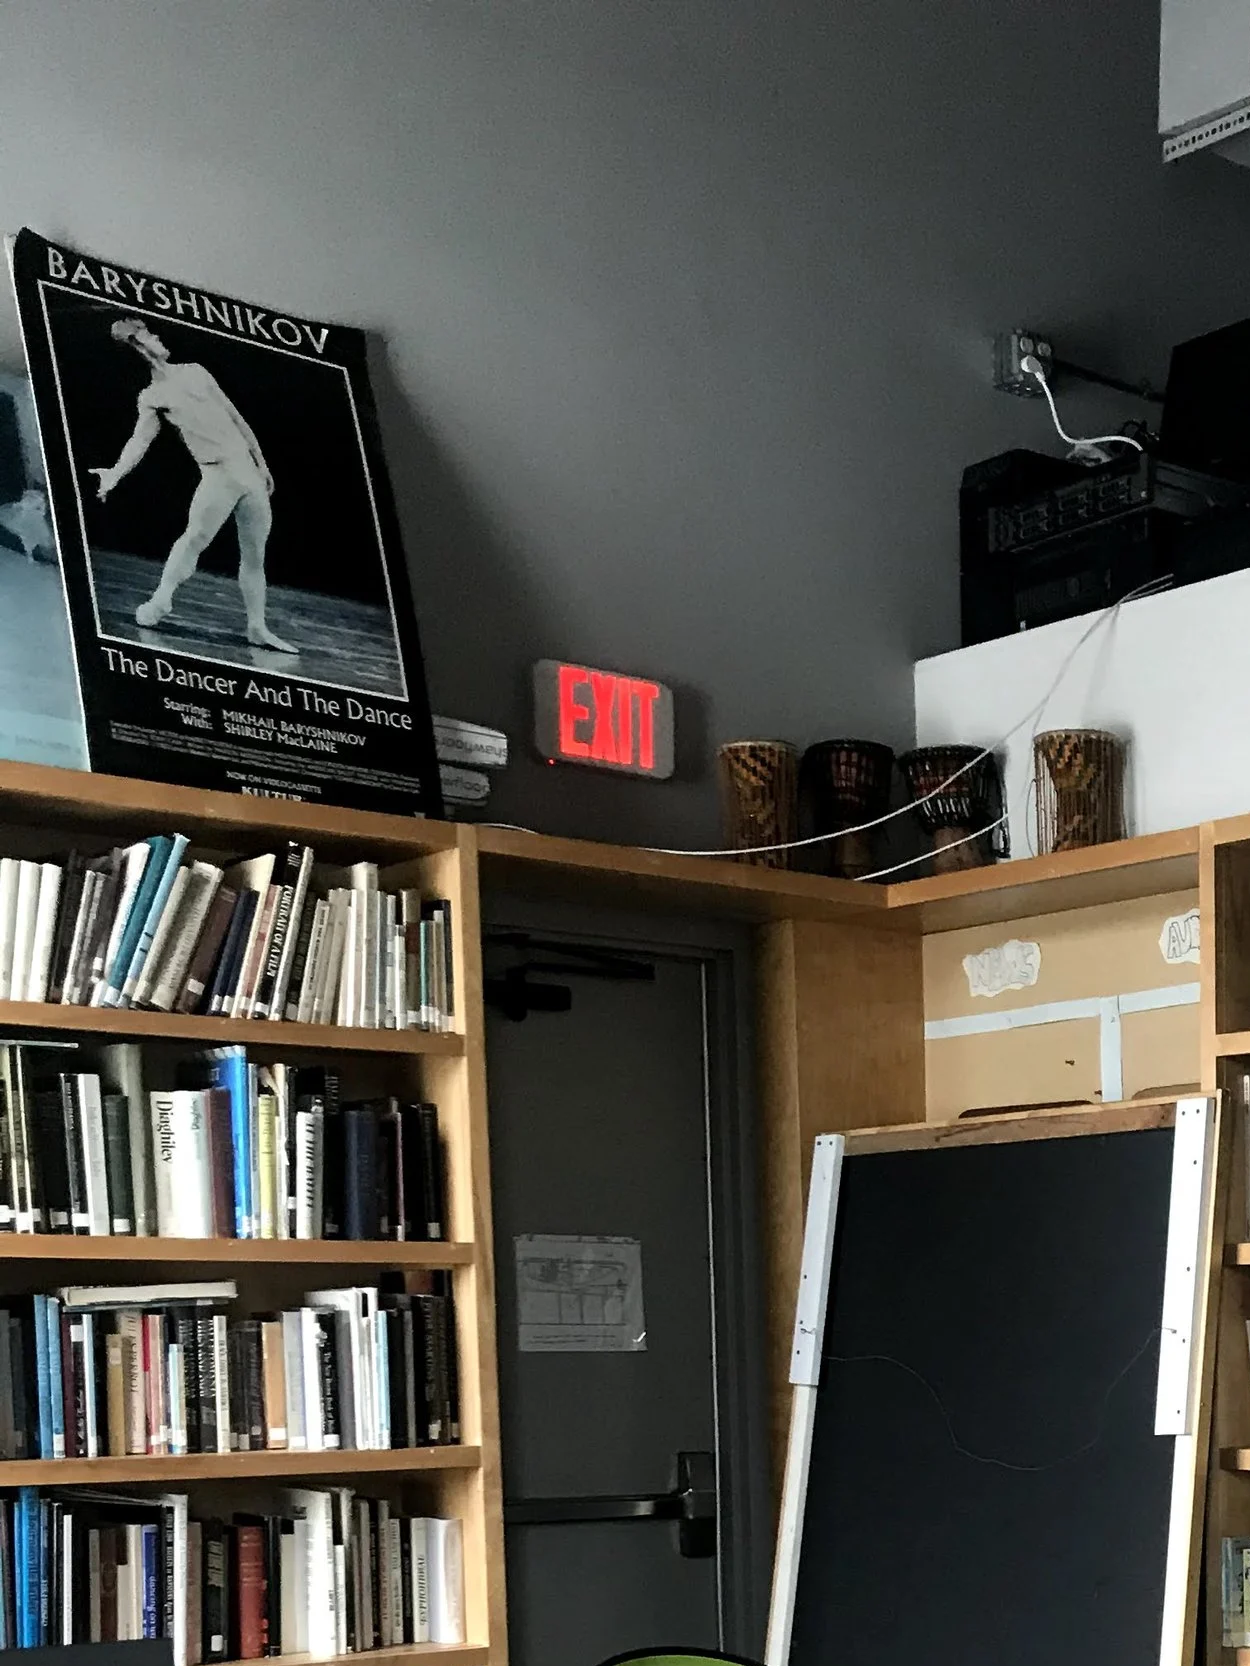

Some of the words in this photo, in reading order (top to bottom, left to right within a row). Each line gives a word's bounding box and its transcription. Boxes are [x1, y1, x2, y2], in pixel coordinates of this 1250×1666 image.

[48, 247, 329, 354] BARYSHNIKOV
[101, 647, 148, 678] The
[156, 659, 238, 697] Dancer
[244, 680, 292, 708] And
[297, 688, 340, 717] The
[346, 698, 413, 731] Dance
[164, 697, 211, 718] Starring:
[222, 709, 276, 729] MIKHAIL
[280, 721, 367, 747] BARYSHNIKOV
[181, 713, 213, 731] With:
[223, 722, 274, 743] SHIRLEY
[277, 732, 338, 754] MacLAINE
[558, 666, 660, 770] EXIT
[275, 884, 294, 932] PORTRAIT
[266, 954, 279, 977] FILM
[155, 1100, 174, 1164] Diaghilev
[146, 1576, 156, 1612] dancing
